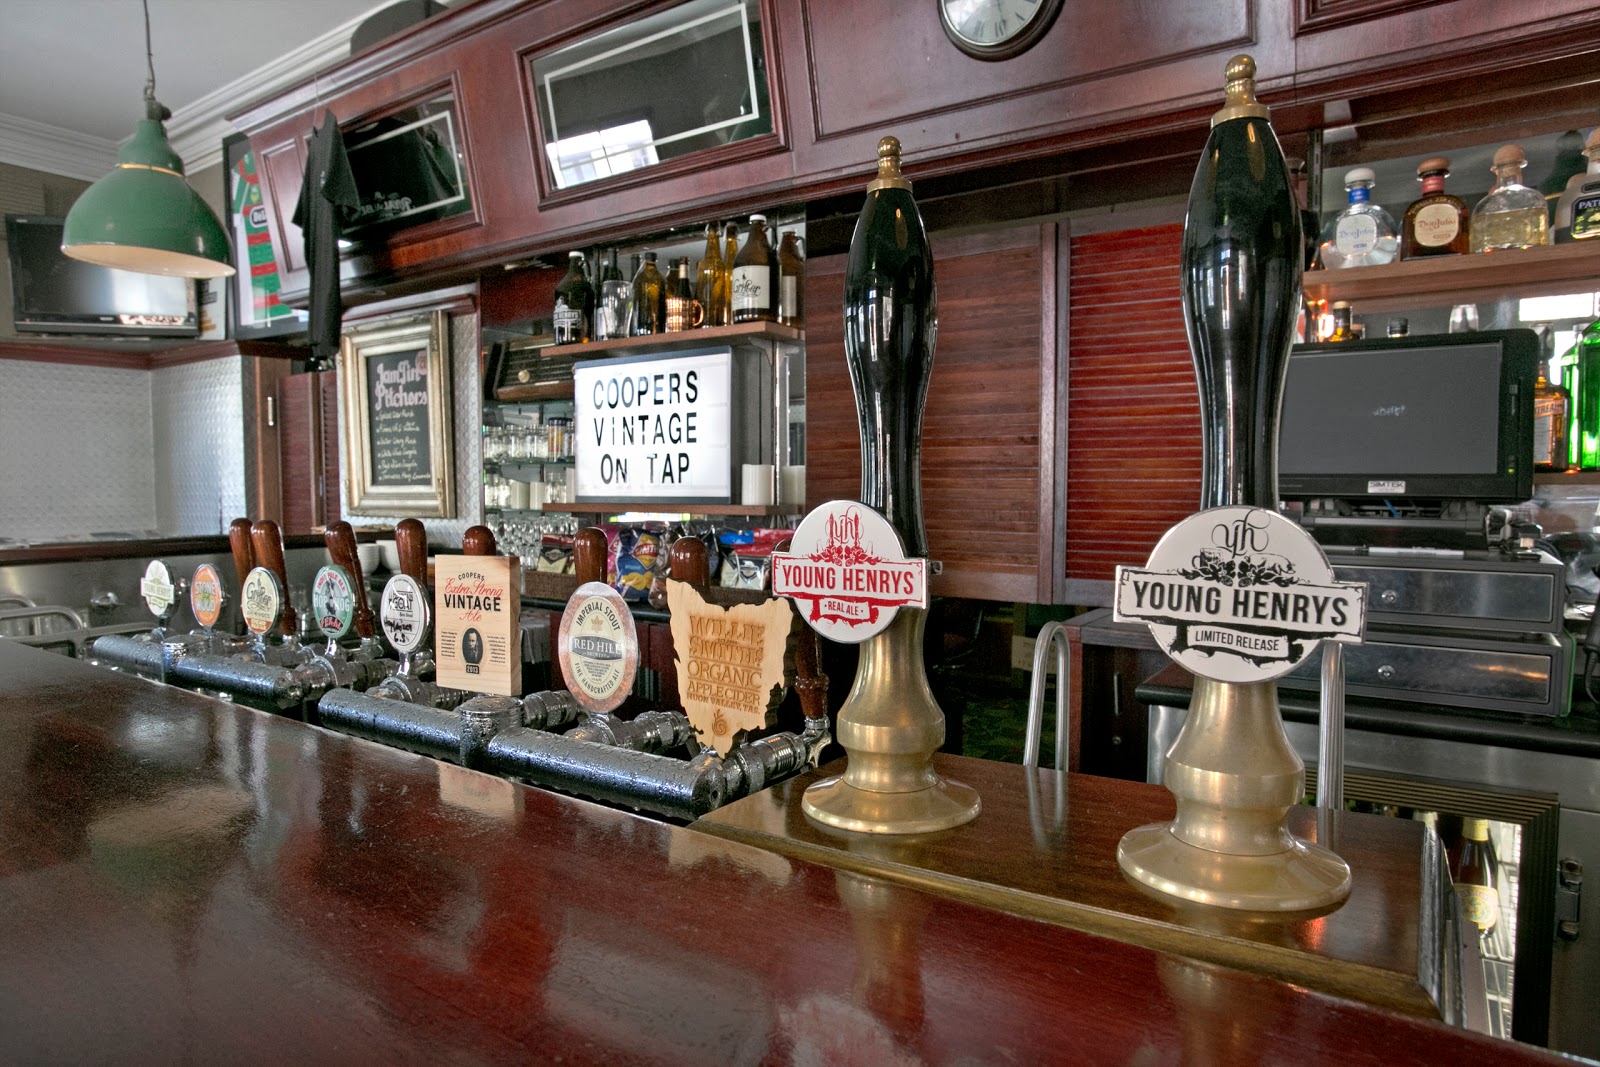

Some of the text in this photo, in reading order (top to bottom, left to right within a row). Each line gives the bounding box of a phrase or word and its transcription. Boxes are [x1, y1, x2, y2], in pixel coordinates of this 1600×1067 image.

[1578, 200, 1600, 209] PAT
[593, 370, 698, 410] COOPERS
[593, 412, 698, 446] VINTAGE
[600, 452, 690, 484] ON TAP
[458, 572, 485, 581] COOPERS
[782, 564, 914, 596] YOUNG HENRYS
[444, 578, 504, 598] Extra Strong
[313, 592, 328, 609] HOP
[443, 593, 501, 612] VINTAGE
[827, 600, 859, 616] REAL ALE
[1132, 580, 1349, 627] YOUNG HENRYS
[459, 608, 483, 622] Ale
[576, 601, 621, 631] IMPERIAL STOUT
[574, 638, 623, 655] RED HILL
[1194, 630, 1280, 652] LIMITED RELEASE
[466, 665, 479, 673] 2013
[574, 662, 583, 677] FINE
[582, 677, 615, 694] HANDCRAFTED
[612, 669, 620, 681] ALE
[687, 659, 763, 689] ORGANIC
[686, 692, 709, 704] HUON
[687, 680, 761, 706] APPLE CIDER
